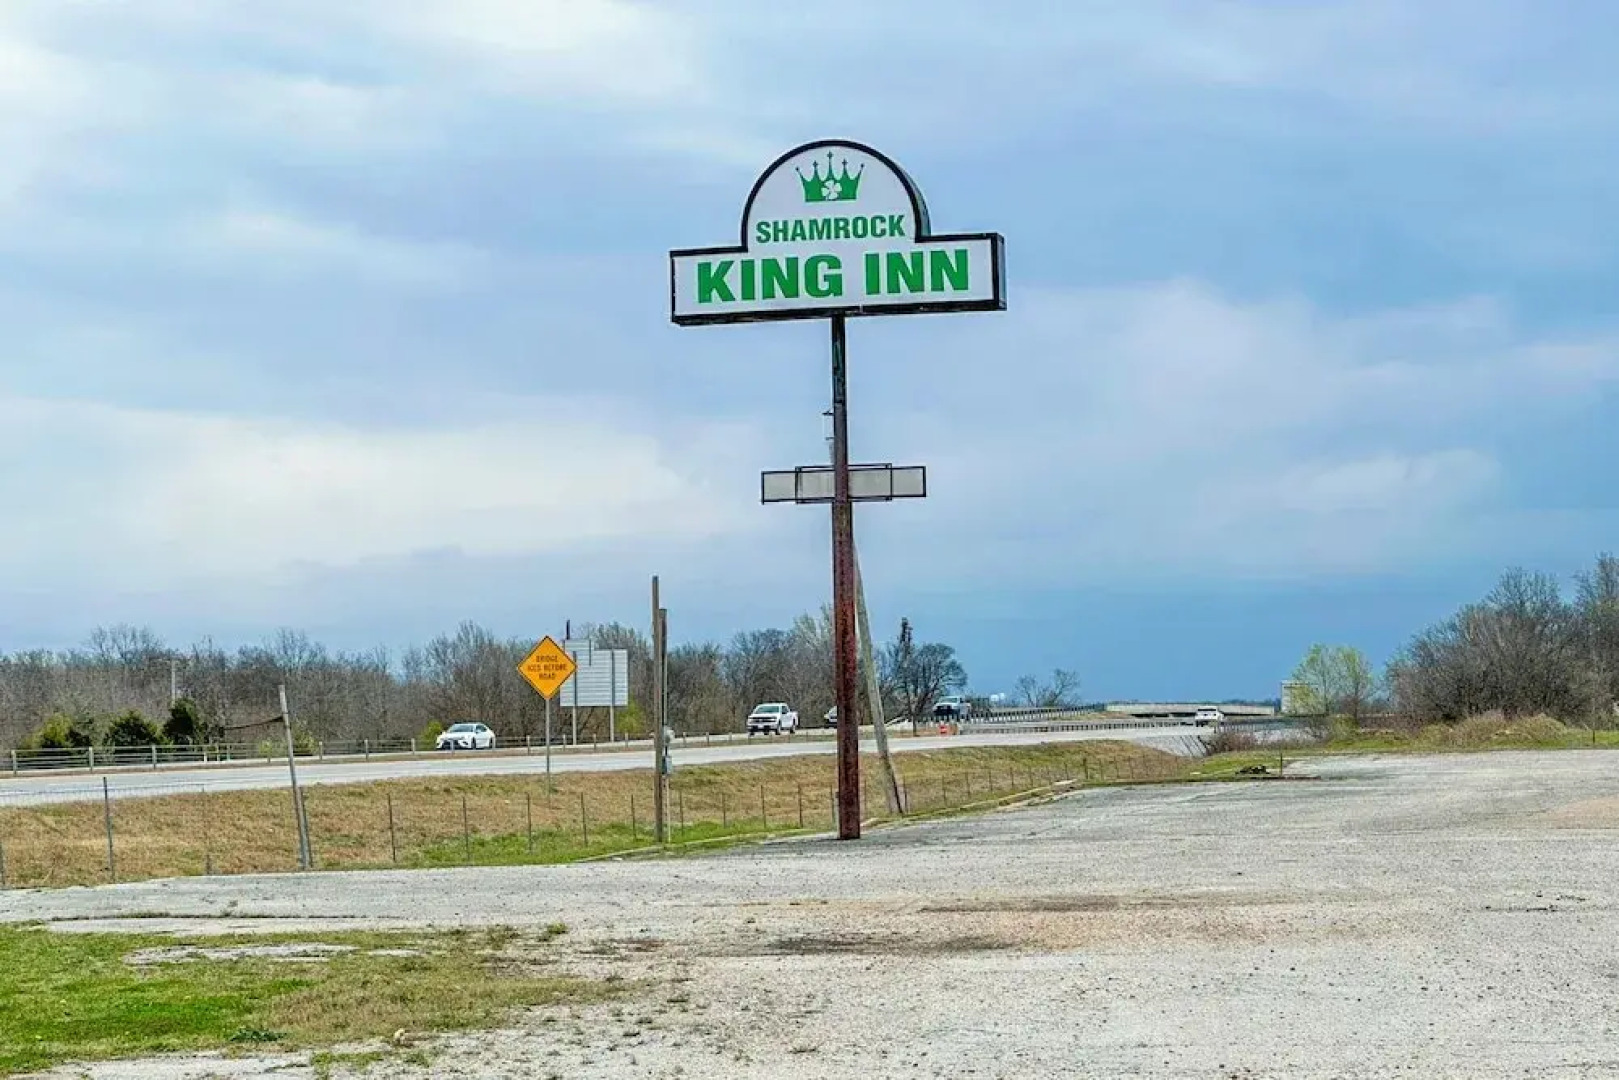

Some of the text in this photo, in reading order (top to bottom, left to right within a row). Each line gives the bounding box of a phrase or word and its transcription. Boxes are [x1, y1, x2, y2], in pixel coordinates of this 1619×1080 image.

[756, 214, 905, 243] SHAMROCK
[697, 249, 969, 303] KING INN
